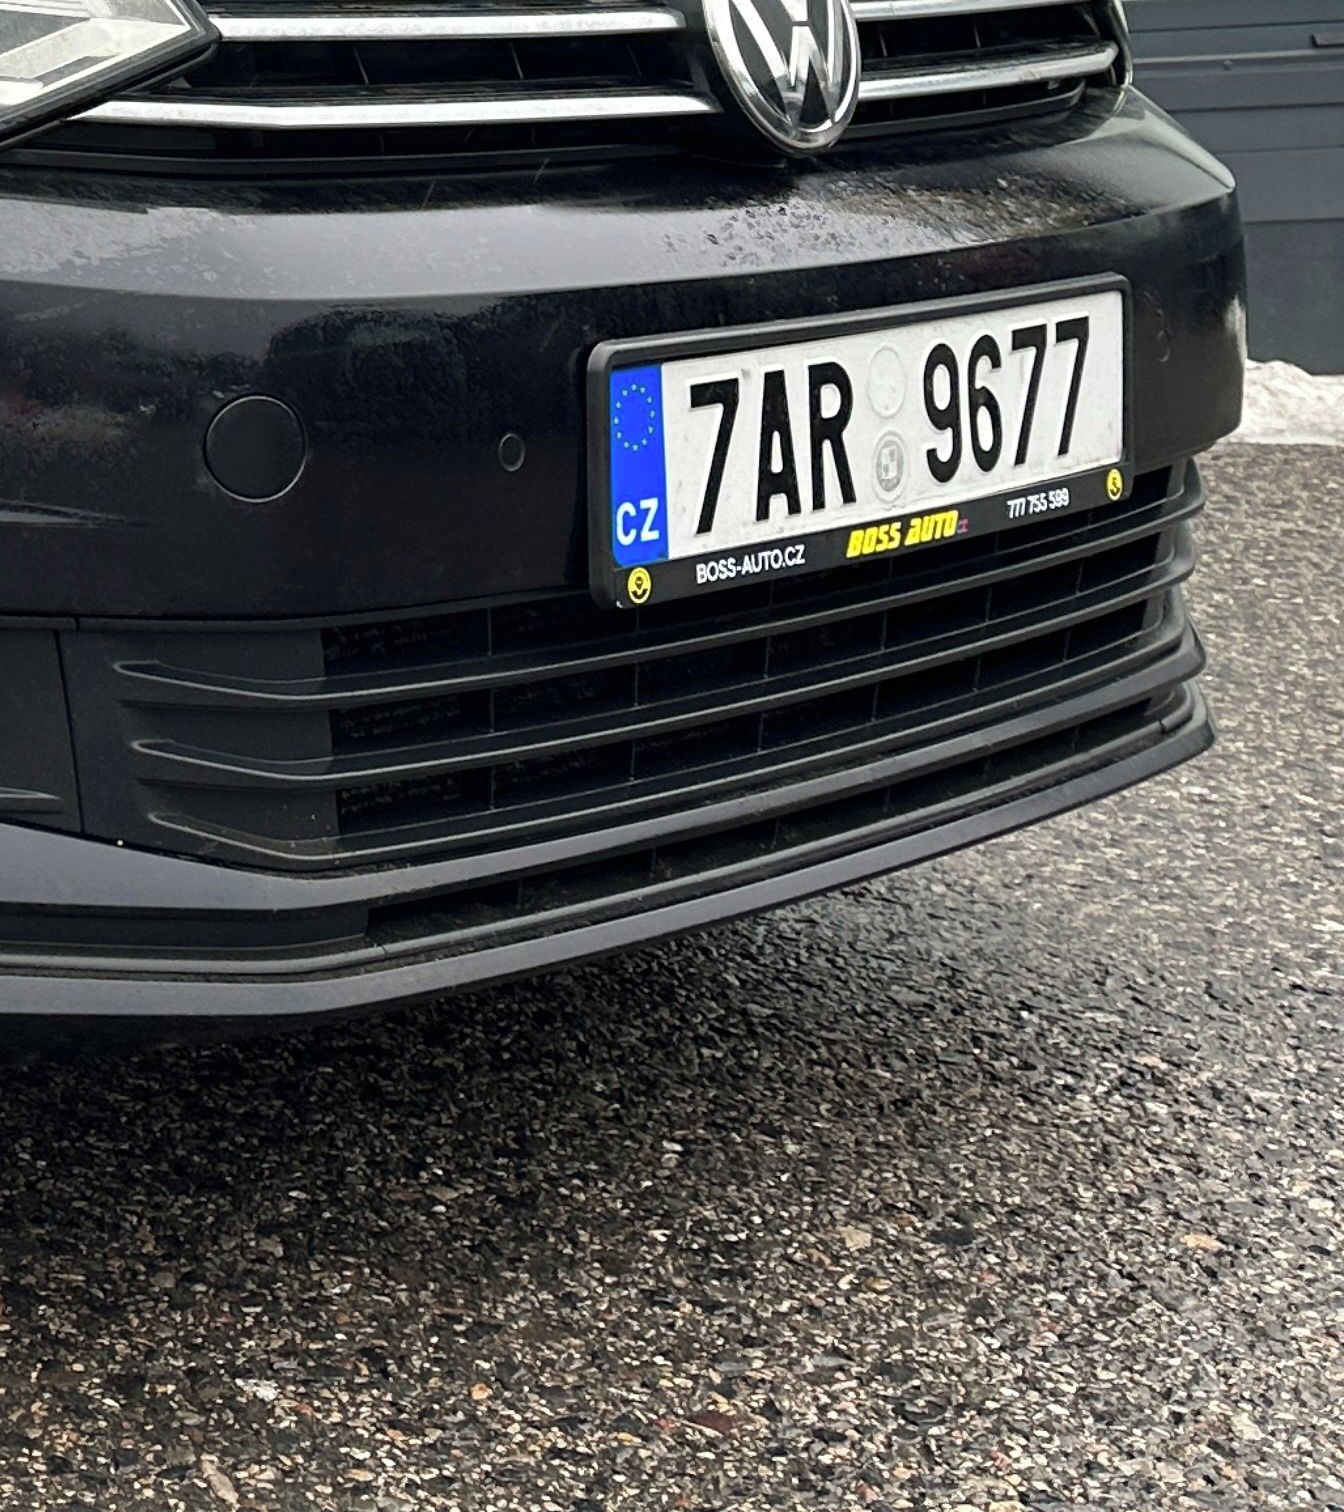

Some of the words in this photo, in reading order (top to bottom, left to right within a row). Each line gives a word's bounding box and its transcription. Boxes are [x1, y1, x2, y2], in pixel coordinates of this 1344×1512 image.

[689, 360, 858, 535] 7AR
[922, 315, 1091, 484] 9677
[615, 496, 660, 547] CZ
[1005, 496, 1027, 520] 777
[1026, 491, 1048, 516] 755
[1047, 487, 1070, 510] 599
[845, 521, 902, 559] BOSS
[903, 509, 960, 547] AUTO
[695, 543, 806, 585] BOSS-AUTO.CZ
